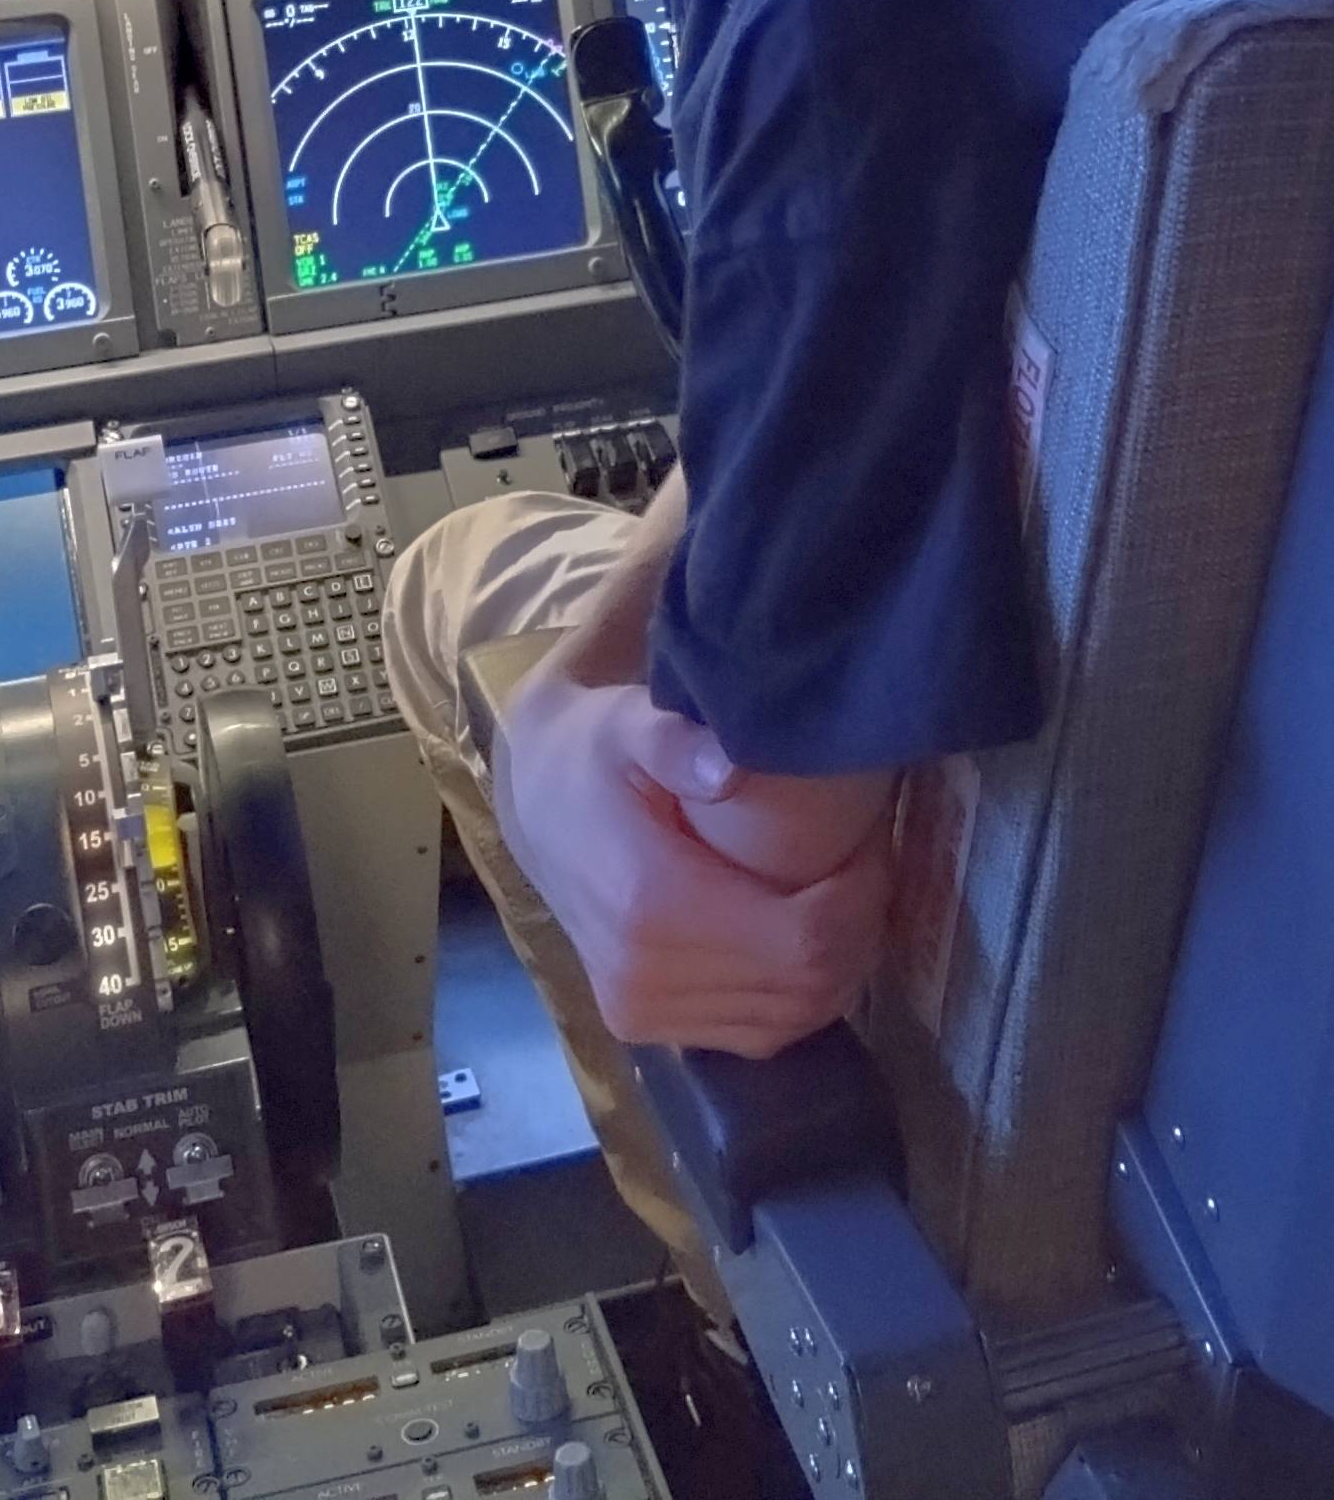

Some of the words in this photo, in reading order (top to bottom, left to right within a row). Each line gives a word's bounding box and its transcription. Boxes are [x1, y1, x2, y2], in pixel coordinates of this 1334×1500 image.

[285, 4, 295, 18] 0
[294, 233, 319, 245] TCAS
[294, 245, 313, 255] OFF
[73, 715, 84, 726] 2
[79, 754, 90, 767] 5
[75, 790, 95, 806] 10
[79, 830, 102, 849] 15
[85, 881, 110, 903] 25
[92, 925, 116, 947] 30
[98, 974, 123, 997] 40
[99, 1000, 133, 1017] FLAP
[100, 1010, 142, 1030] DOWN
[91, 1101, 139, 1120] STAB
[142, 1088, 188, 1107] TRIM
[177, 1105, 209, 1120] AUTO
[113, 1118, 171, 1140] NORMAL
[178, 1114, 210, 1128] PILOT
[158, 1236, 204, 1303] 2
[492, 1438, 552, 1457] STANDBY
[317, 1483, 364, 1499] ACTIVE
